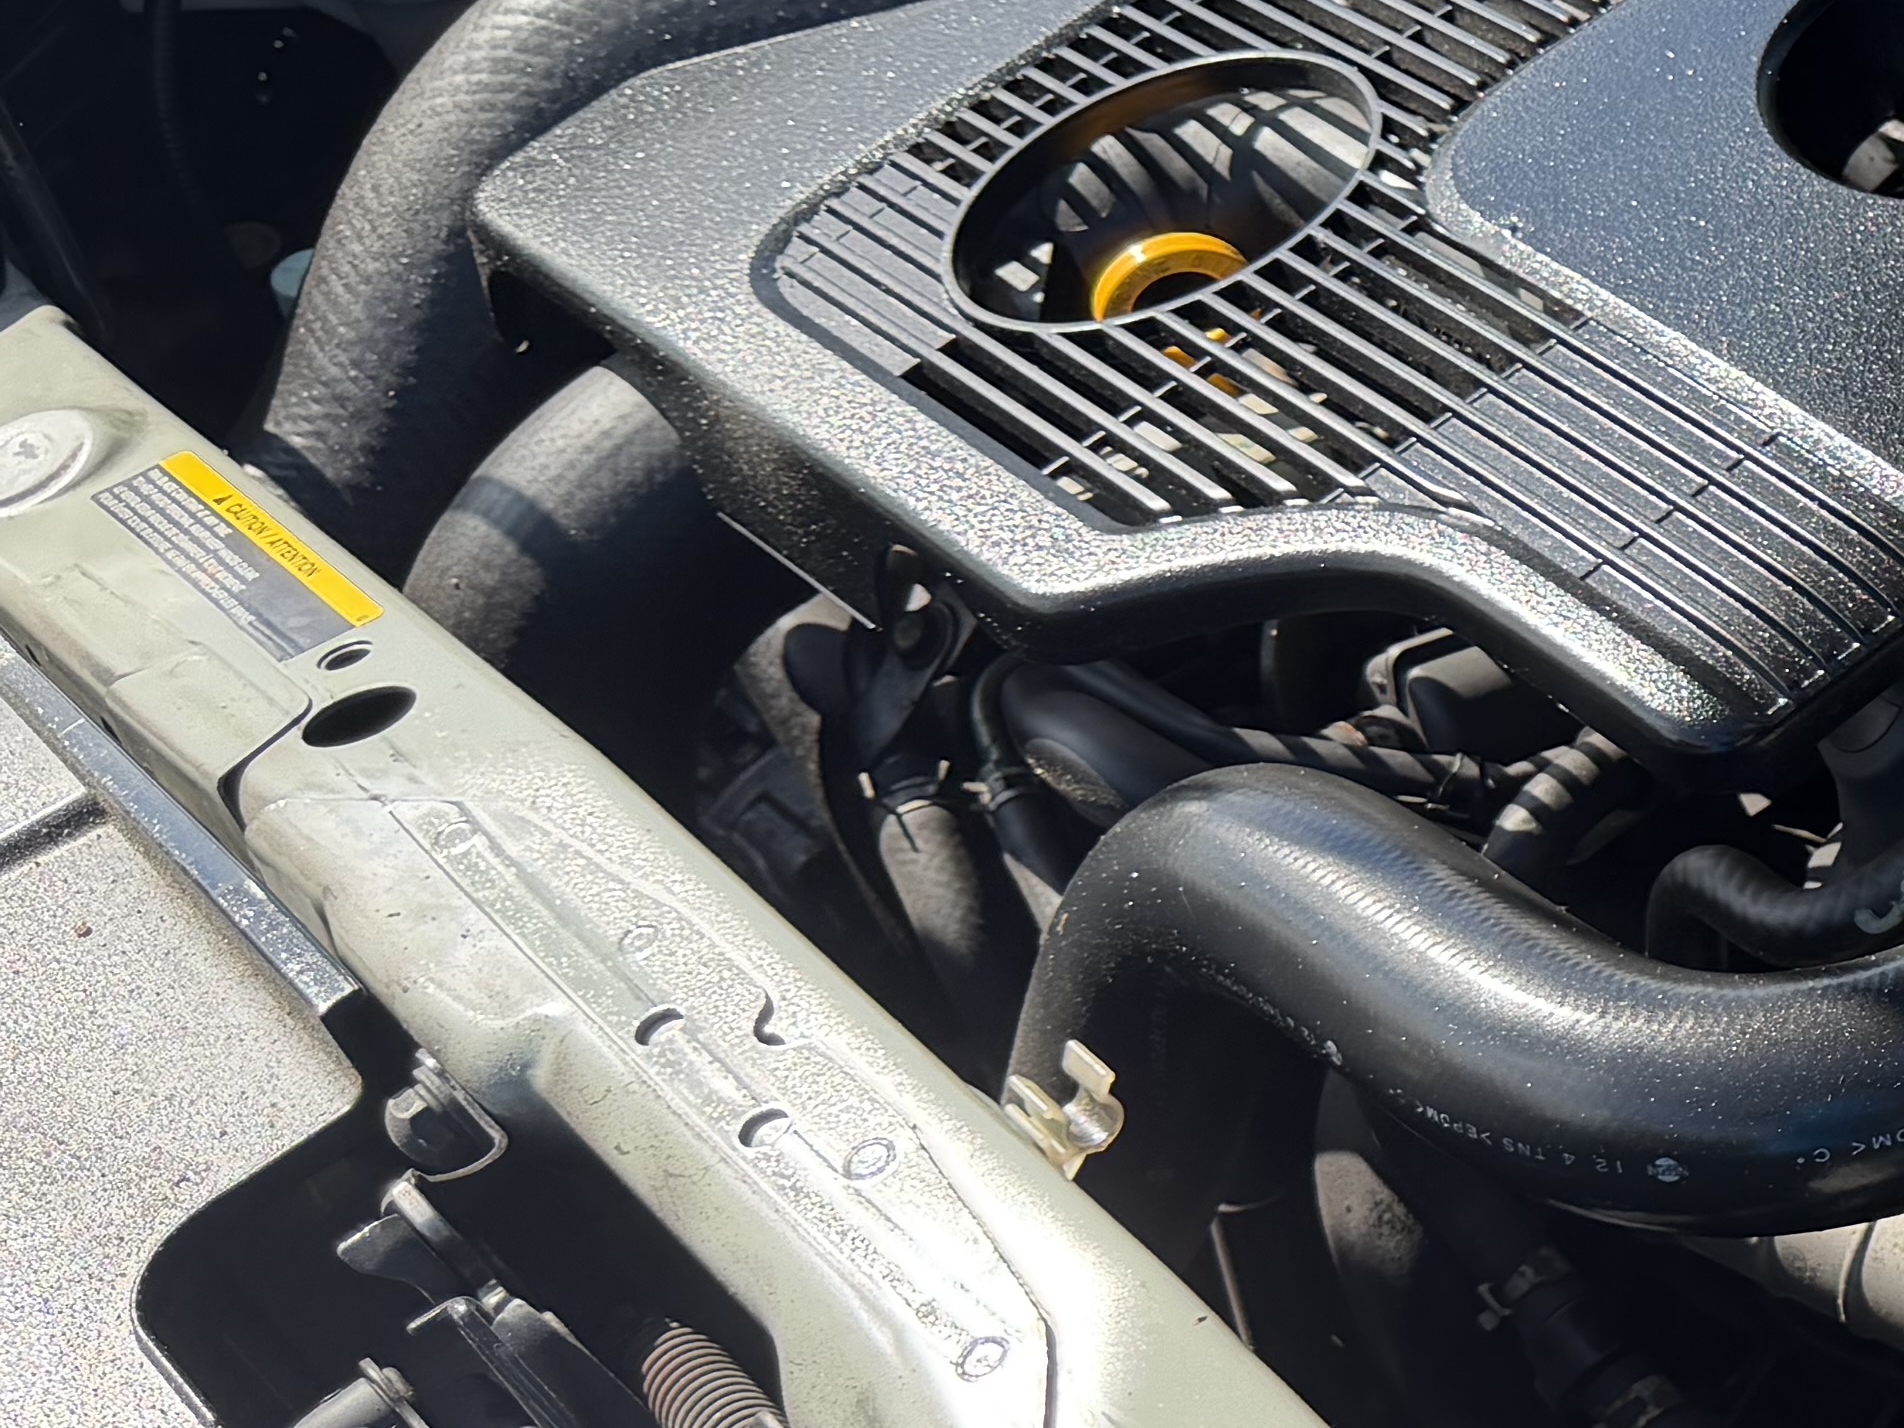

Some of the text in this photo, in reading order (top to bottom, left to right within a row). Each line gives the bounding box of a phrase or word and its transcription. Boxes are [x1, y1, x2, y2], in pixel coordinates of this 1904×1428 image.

[225, 503, 272, 536] CAUTION
[266, 538, 322, 577] ATTENTION
[1502, 1136, 1547, 1161] TNS
